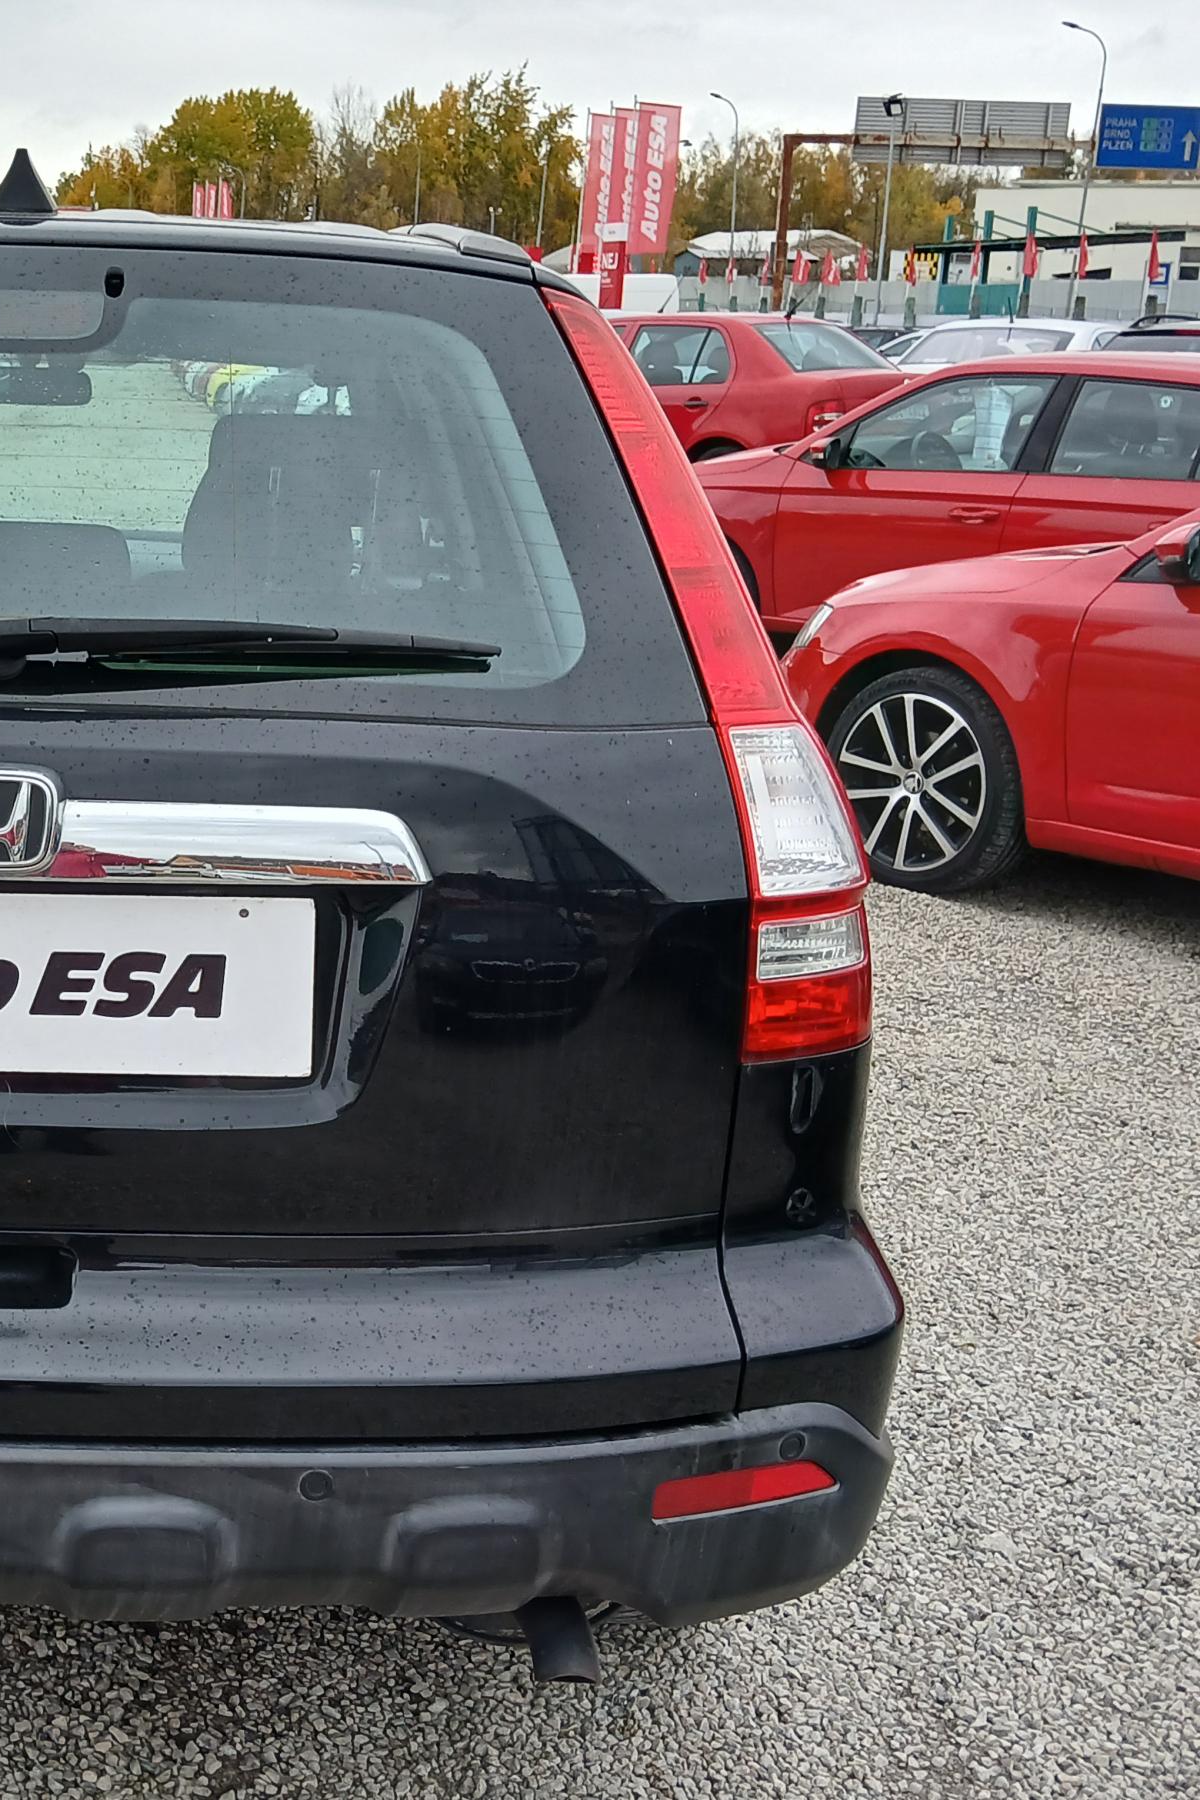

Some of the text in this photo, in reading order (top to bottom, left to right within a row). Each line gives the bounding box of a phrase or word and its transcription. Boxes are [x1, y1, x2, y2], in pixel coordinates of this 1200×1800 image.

[1103, 128, 1131, 139] BRNO
[1105, 117, 1138, 128] PRAHA
[640, 114, 668, 243] Auto ESA
[28, 950, 228, 1019] ESA
